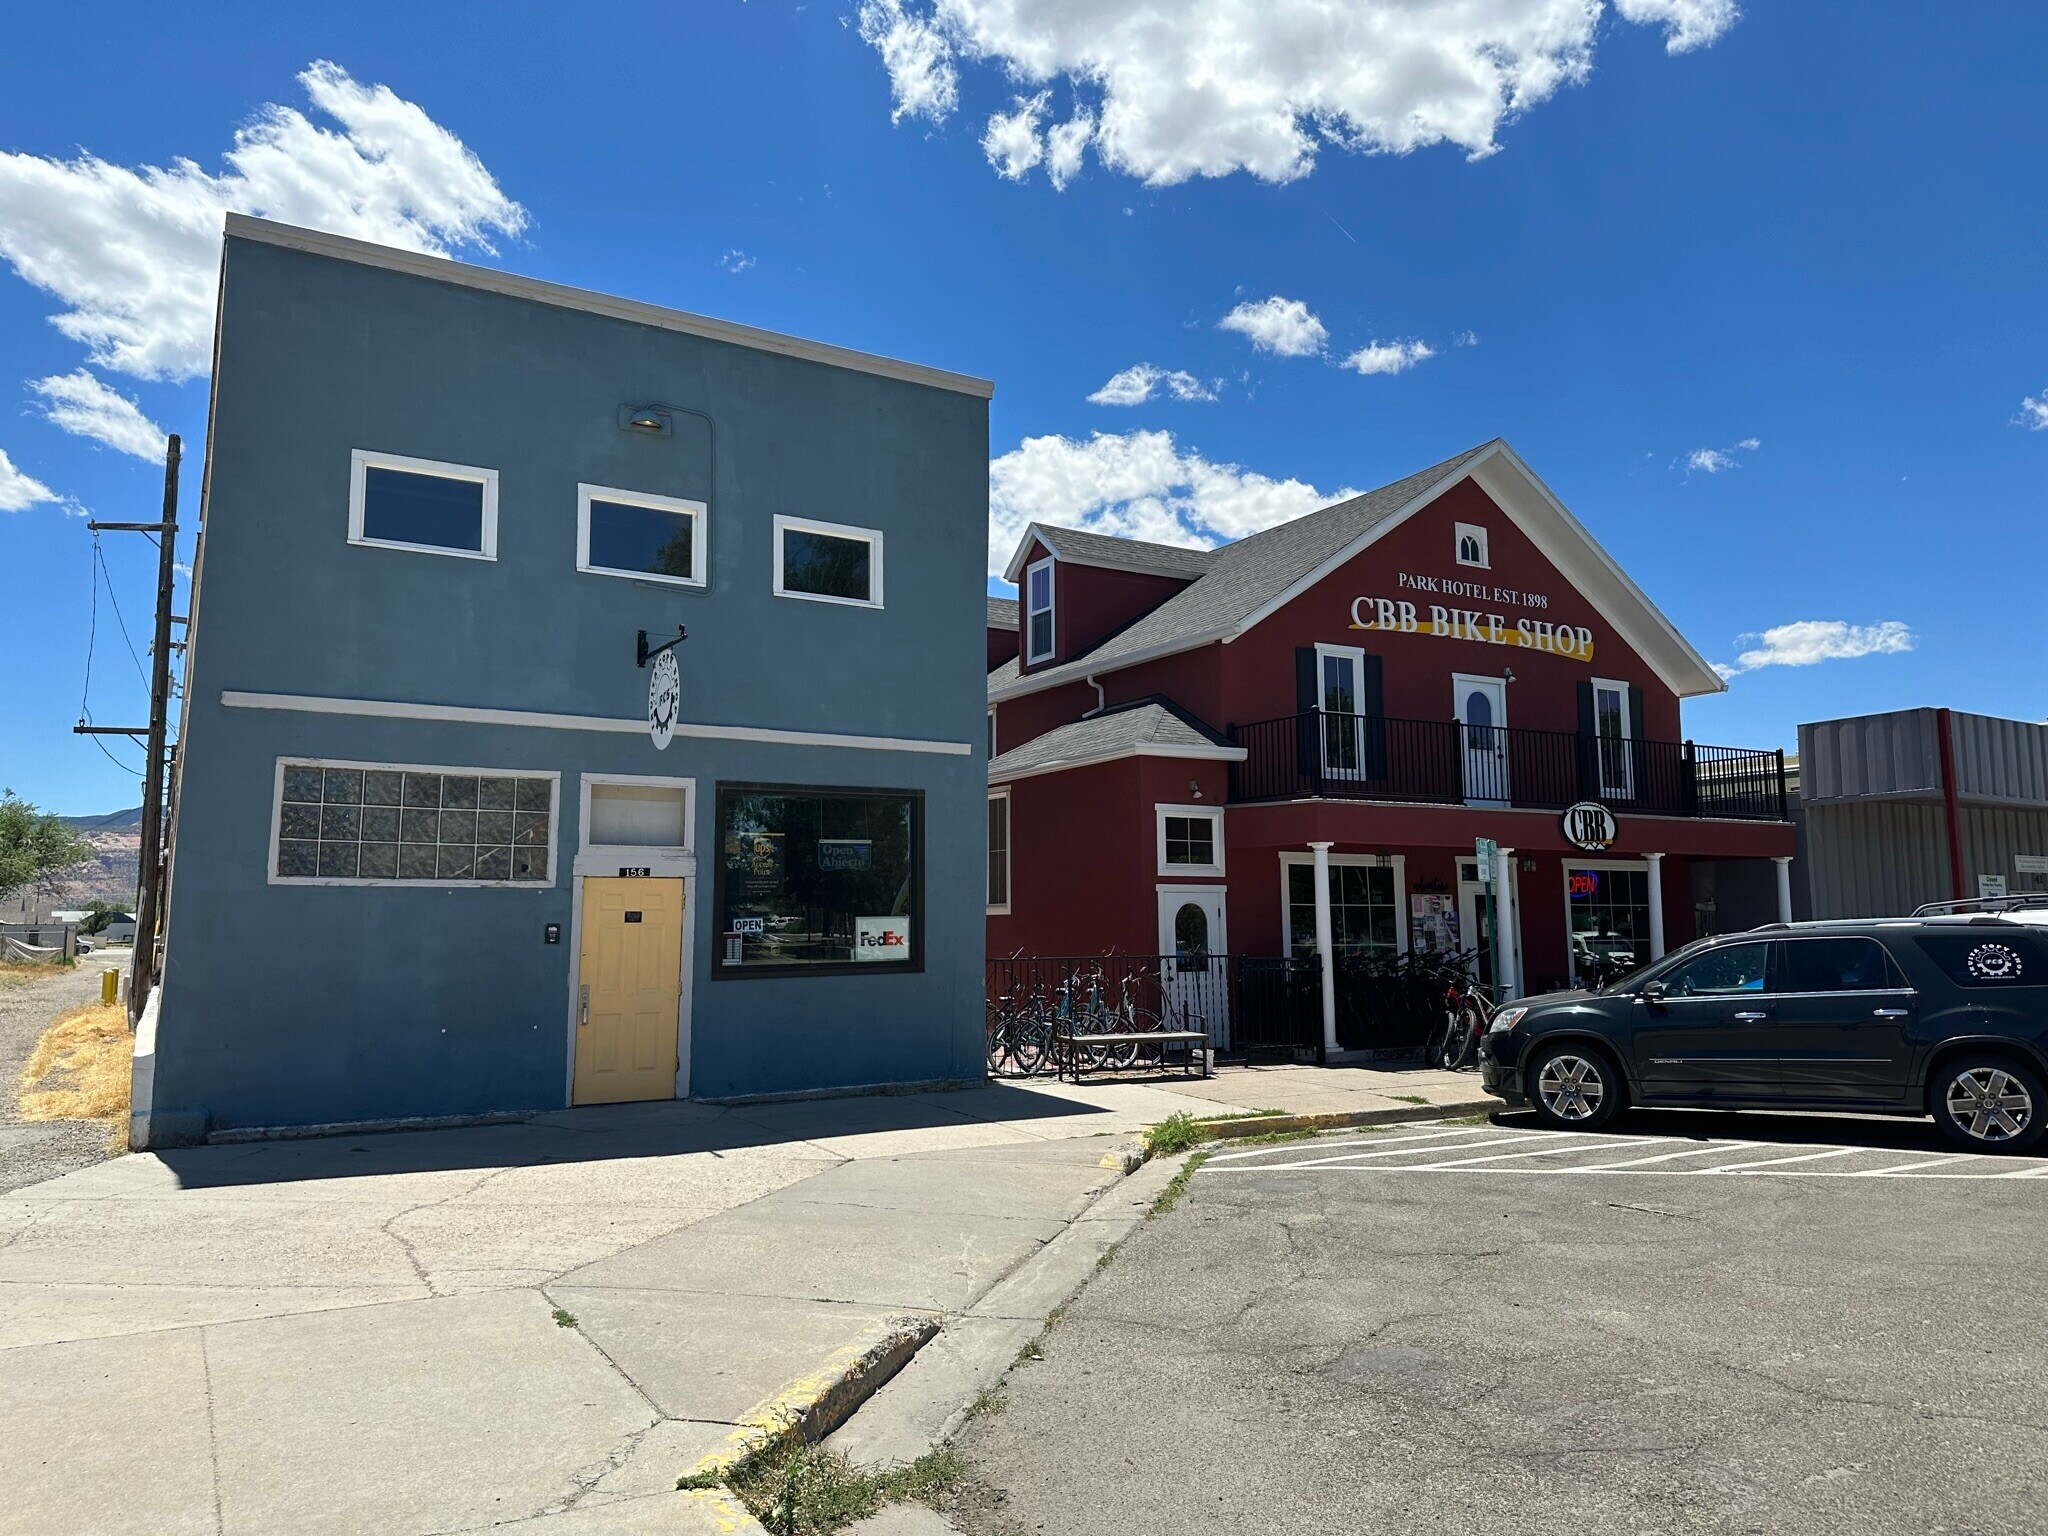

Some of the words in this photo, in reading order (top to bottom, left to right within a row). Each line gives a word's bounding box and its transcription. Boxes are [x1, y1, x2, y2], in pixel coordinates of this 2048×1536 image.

[1398, 572, 1439, 593] PARK
[1442, 579, 1491, 600] HOTEL
[1493, 588, 1520, 605] EST.
[1522, 592, 1548, 609] 1898
[1350, 596, 1418, 633] CBB
[1428, 605, 1507, 645] BIKE
[1517, 618, 1593, 656] SHOP
[1570, 808, 1607, 842] CBB
[822, 844, 854, 856] Open
[822, 856, 865, 867] Abierto
[626, 868, 645, 876] 156
[1567, 876, 1595, 893] OPEN
[735, 919, 762, 931] OPEN
[860, 930, 904, 946] FedEx
[1981, 943, 2010, 952] COPY
